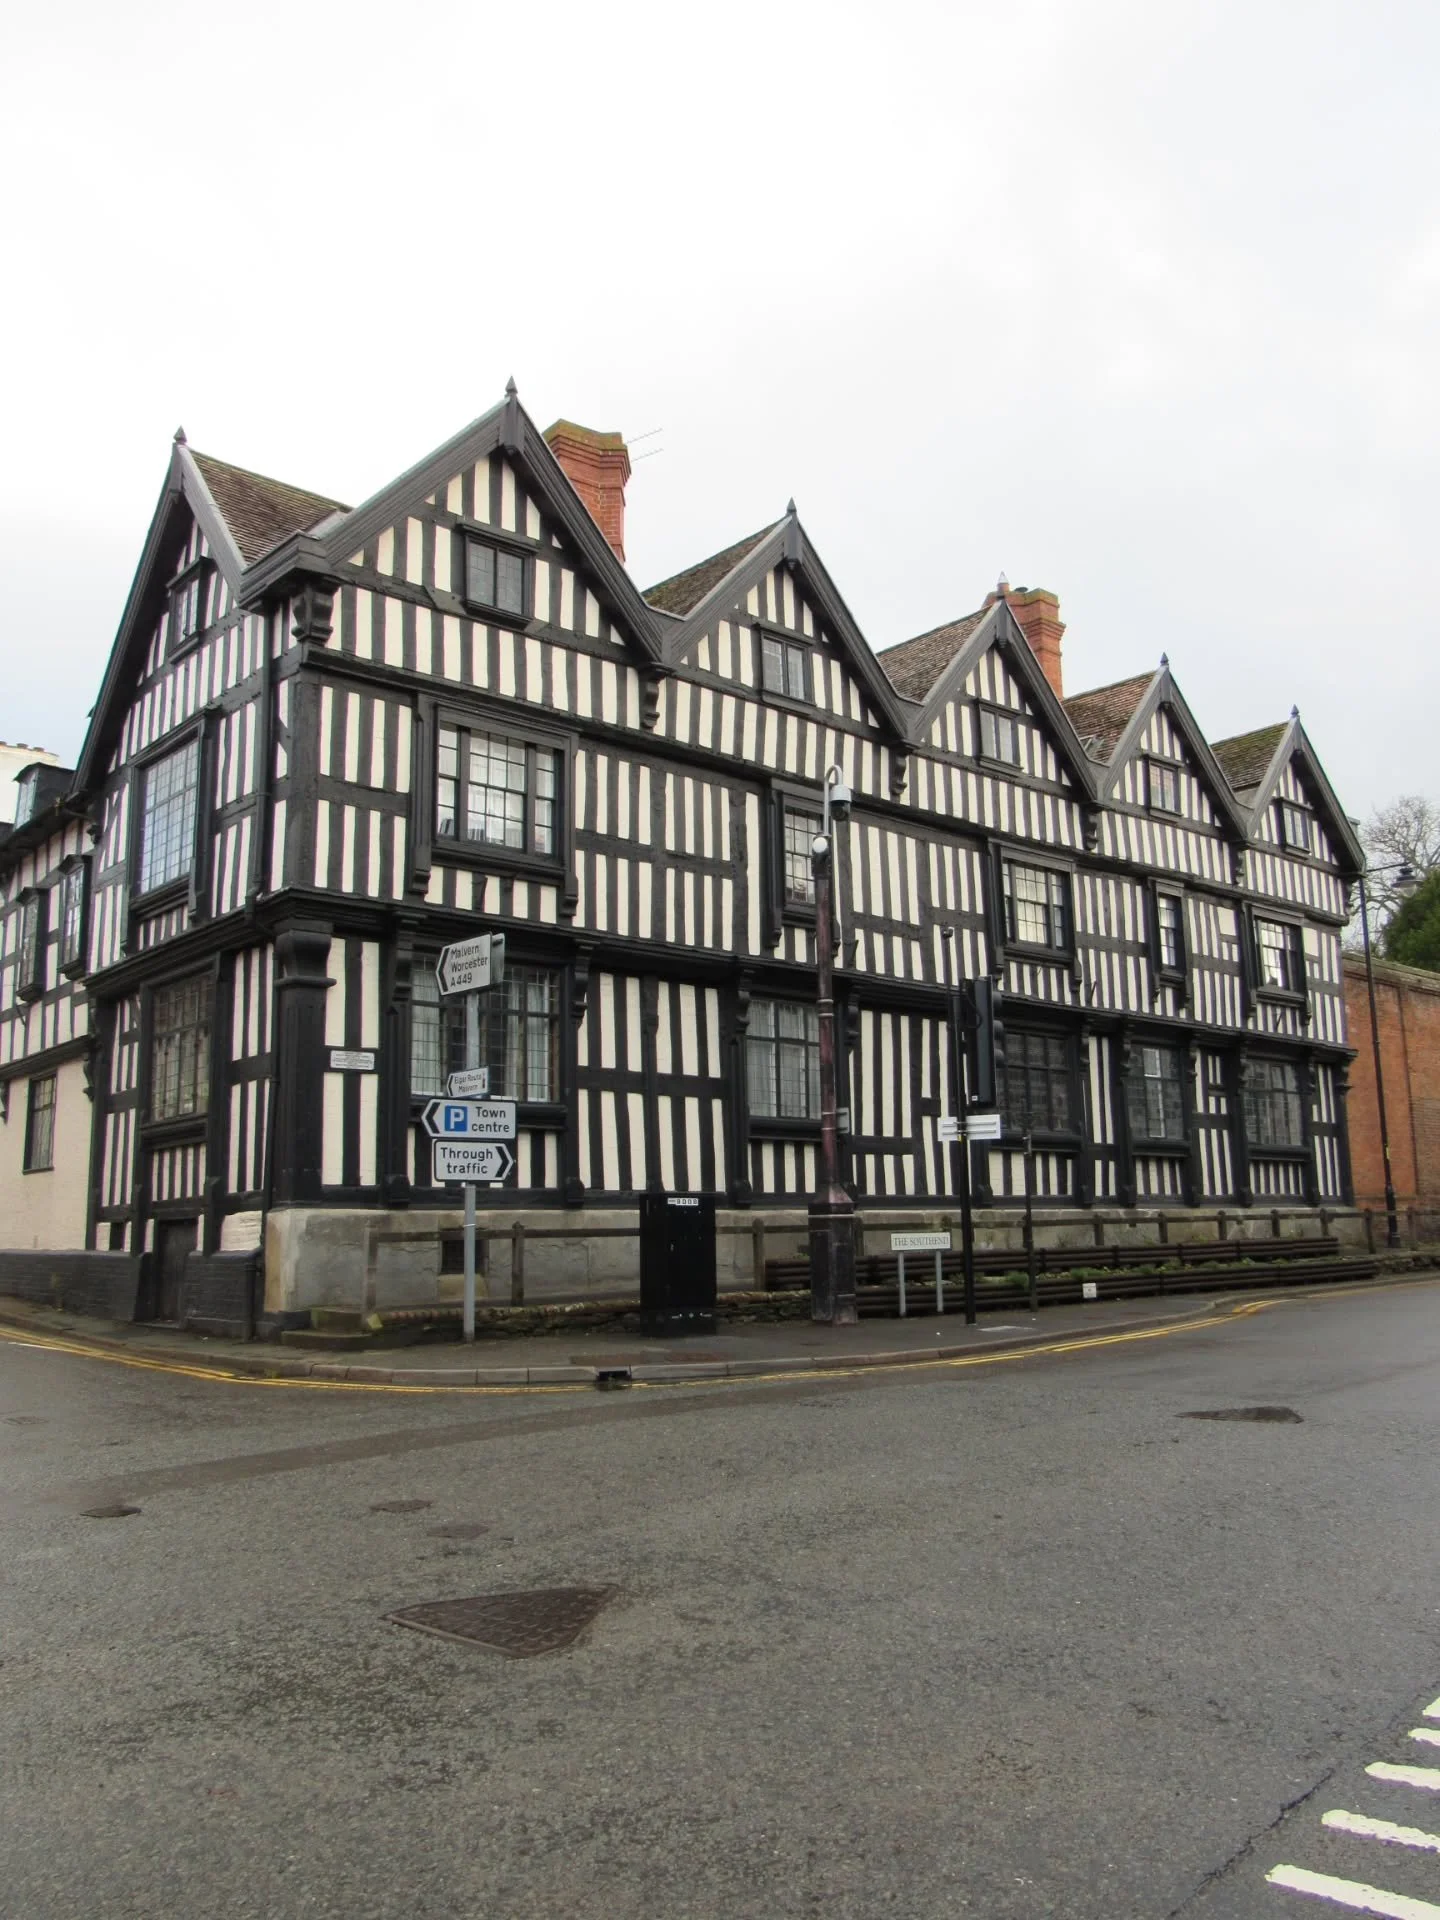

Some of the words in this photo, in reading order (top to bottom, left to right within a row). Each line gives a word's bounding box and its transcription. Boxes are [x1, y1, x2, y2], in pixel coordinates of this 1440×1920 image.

[451, 944, 479, 959] Malvern
[451, 956, 488, 973] Worcester
[450, 1108, 464, 1129] P
[476, 1107, 506, 1118] Town
[471, 1122, 510, 1133] centre
[441, 1147, 493, 1161] Through
[447, 1163, 488, 1174] traffic
[893, 1237, 909, 1247] THE
[910, 1236, 949, 1246] SOUTHEND
